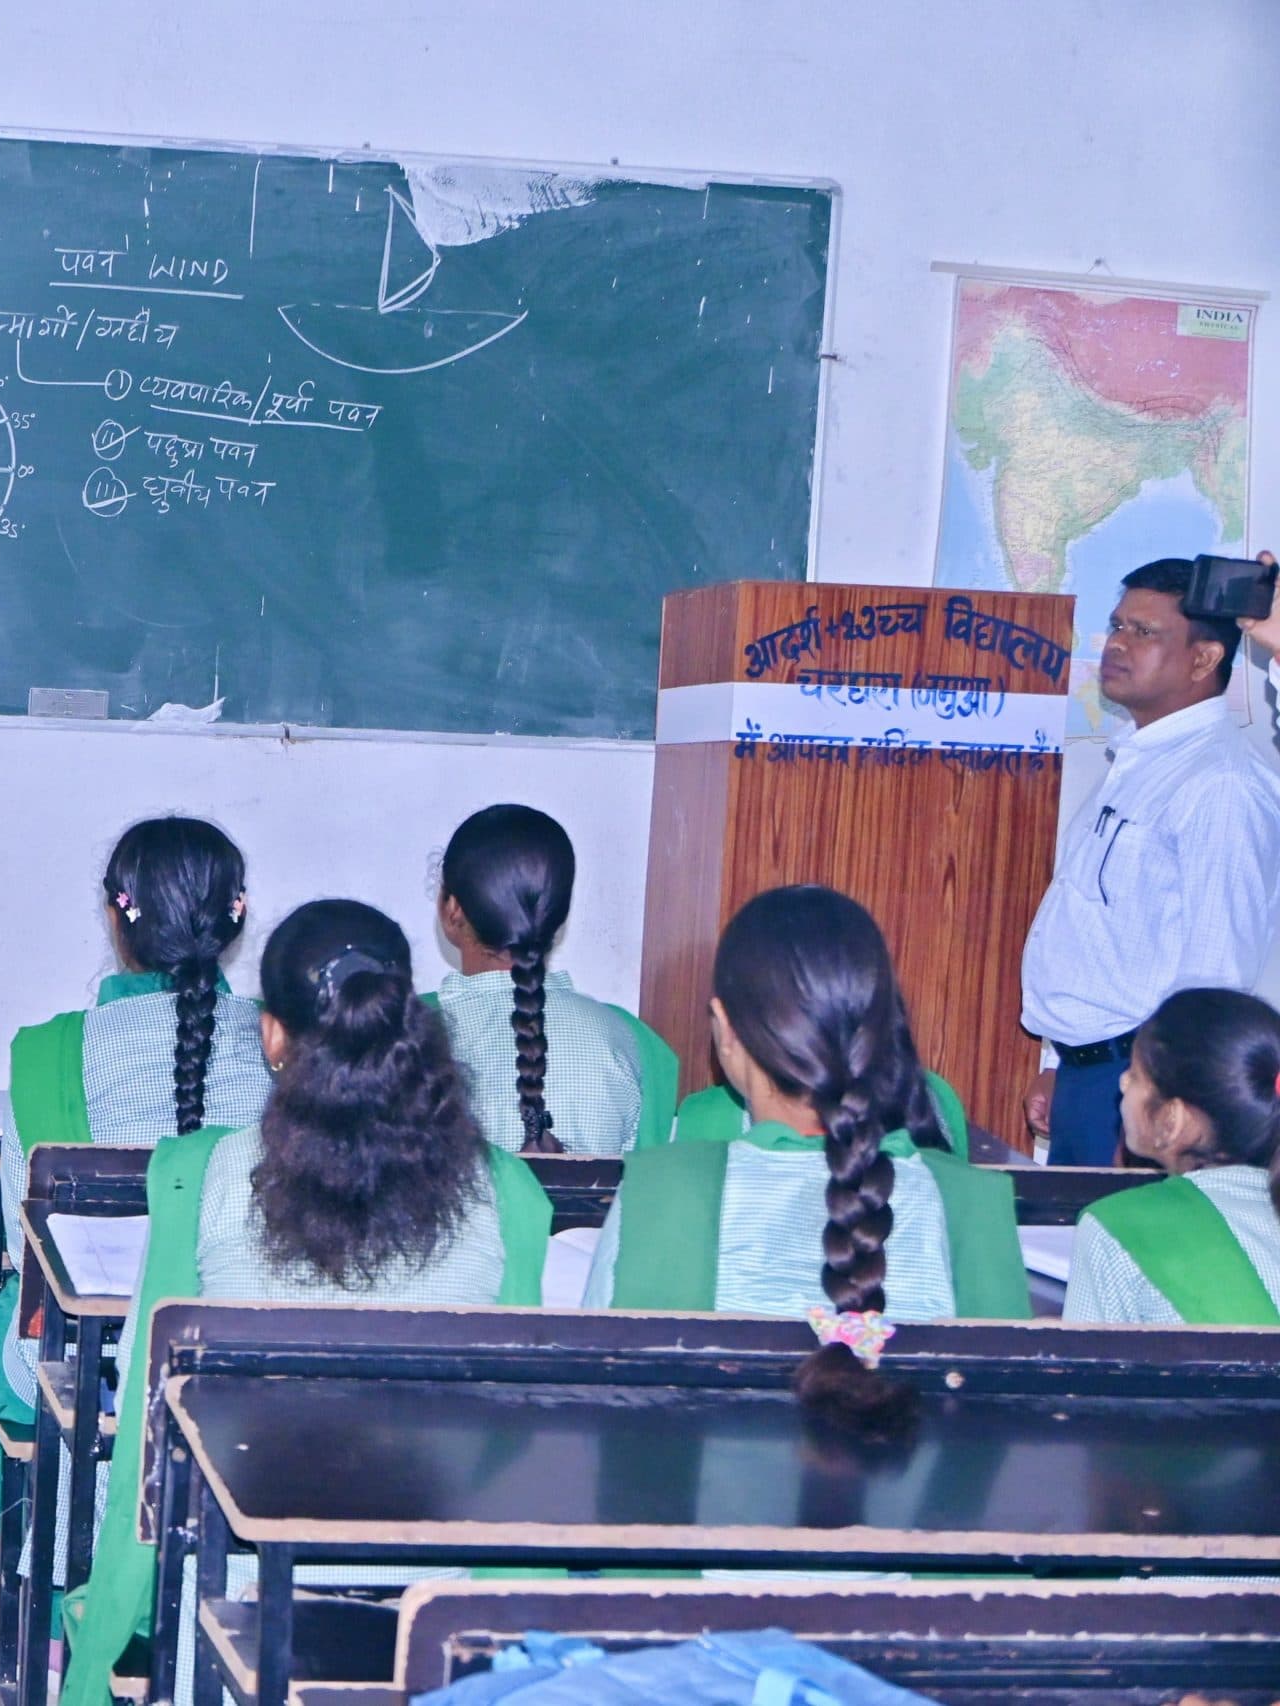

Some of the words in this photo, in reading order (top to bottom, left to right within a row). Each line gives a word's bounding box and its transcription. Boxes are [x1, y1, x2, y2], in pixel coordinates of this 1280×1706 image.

[54, 247, 127, 278] पवन
[148, 253, 229, 286] WIND
[1196, 308, 1244, 323] INDIA
[327, 399, 384, 429] पवन
[209, 437, 259, 469] पवन
[215, 475, 277, 507] पवन
[744, 605, 822, 678] आदर्श
[944, 595, 1073, 685] विद्यालय
[734, 717, 764, 760] में
